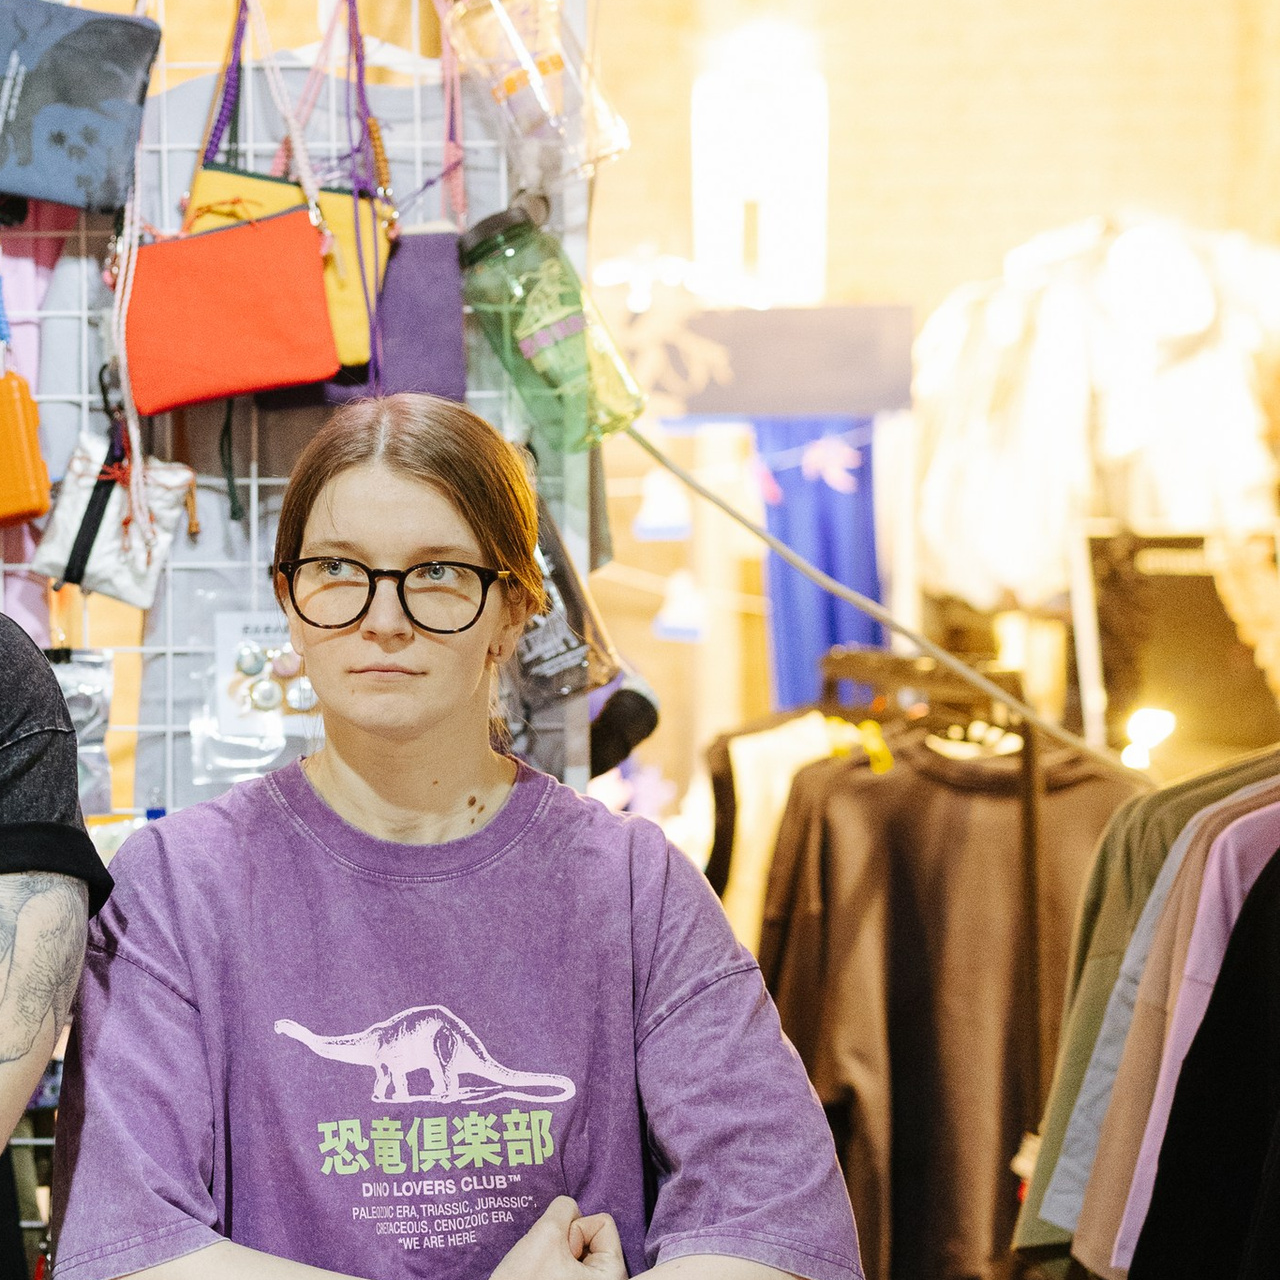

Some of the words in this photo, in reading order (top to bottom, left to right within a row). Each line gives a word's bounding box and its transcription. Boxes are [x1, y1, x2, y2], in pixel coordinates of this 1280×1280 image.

[362, 1181, 390, 1198] DINO
[393, 1179, 457, 1197] LOVERS
[352, 1205, 394, 1220] PALEOZOIC
[396, 1205, 420, 1220] ERA,
[420, 1200, 473, 1217] TRIASSIC,
[375, 1220, 432, 1235] CRETACEOUS,
[434, 1212, 489, 1232] CENOZOIC
[491, 1210, 515, 1223] ERA
[423, 1234, 446, 1249] ARE
[447, 1230, 478, 1247] HERE
